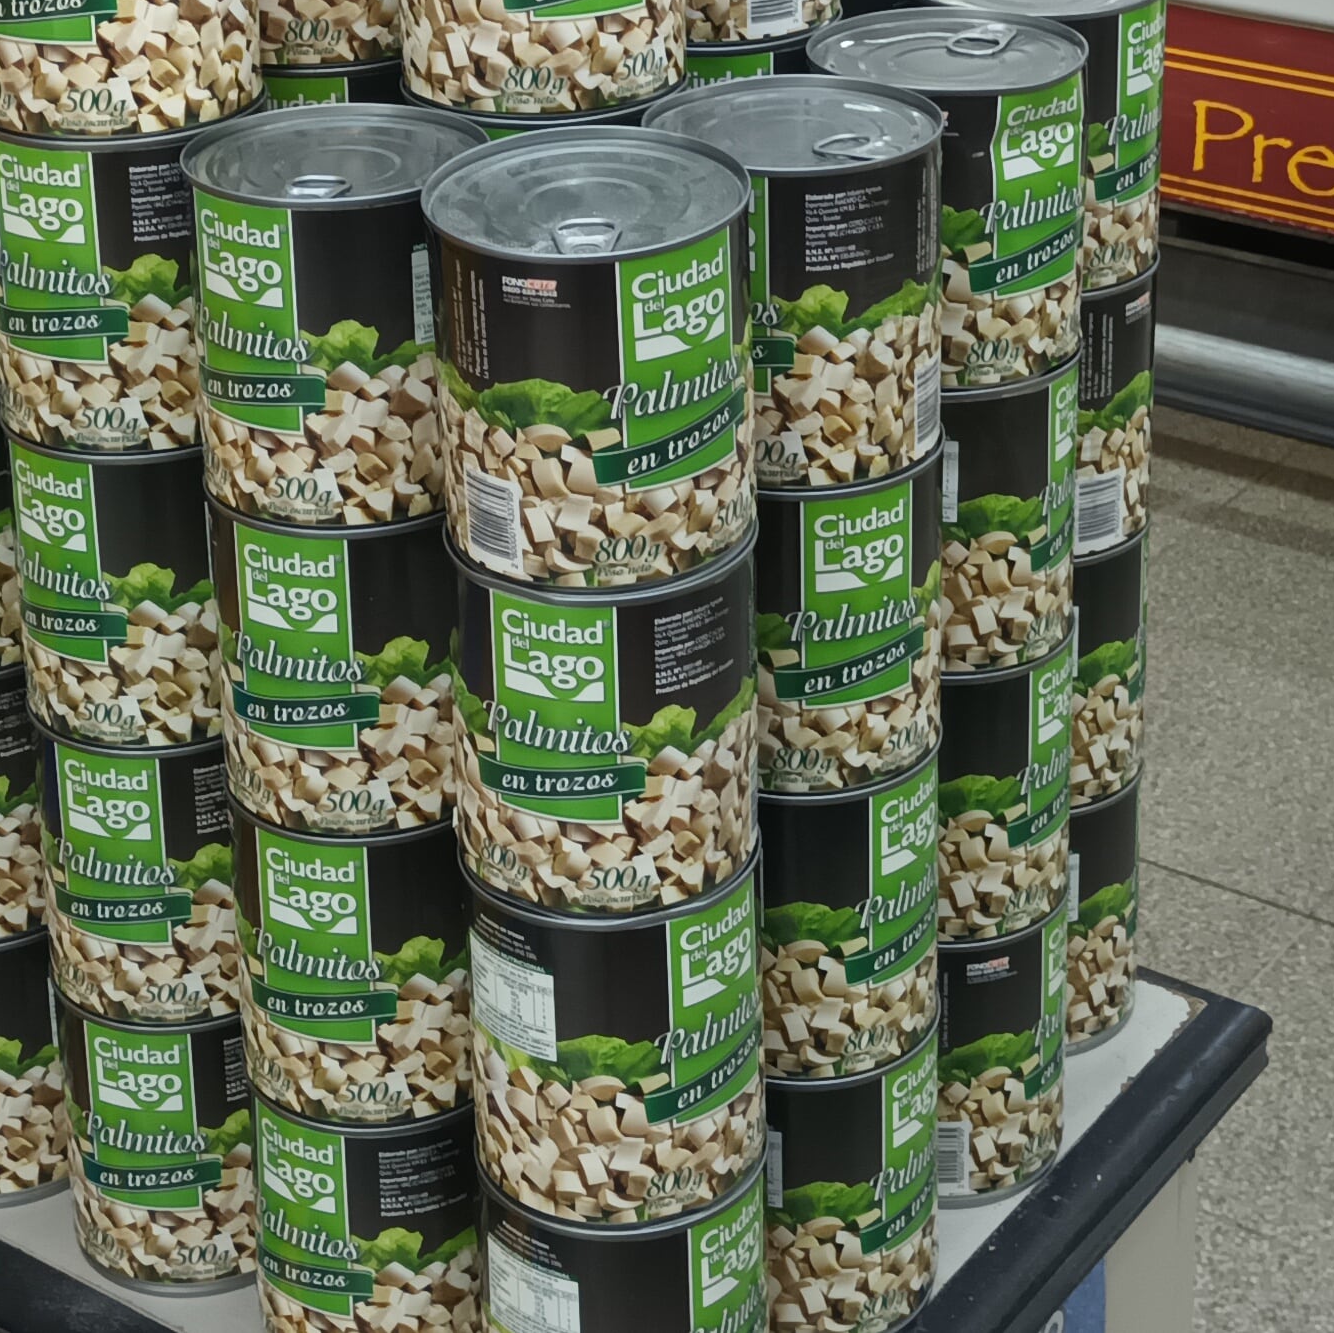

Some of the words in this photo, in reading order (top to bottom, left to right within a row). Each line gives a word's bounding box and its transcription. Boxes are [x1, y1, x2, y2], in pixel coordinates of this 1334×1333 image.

[1007, 90, 1078, 126] Ciudad
[1001, 121, 1074, 161] Lago
[2, 178, 84, 230] Lago
[6, 180, 20, 191] del
[981, 181, 1082, 233] Palmitos
[200, 209, 281, 249] Ciudad
[209, 237, 221, 250] del
[203, 234, 283, 294] Lago
[995, 262, 1021, 283] en
[1026, 229, 1076, 271] trozos
[632, 256, 725, 299] Ciudad
[9, 314, 27, 330] en
[32, 310, 100, 331] trozos
[634, 287, 725, 335] Lago
[645, 300, 664, 314] del
[198, 309, 310, 362] Palmitos
[207, 379, 223, 396] en
[227, 382, 295, 400] trozos
[604, 354, 740, 419] Palmitos
[627, 452, 661, 474] en
[667, 407, 732, 460] trozos
[813, 499, 905, 536] Ciudad
[243, 544, 337, 579] Ciudad
[815, 534, 904, 576] Lago
[825, 539, 844, 551] del
[248, 567, 338, 621] Lago
[252, 569, 267, 582] del
[501, 609, 603, 645] Ciudad
[784, 594, 918, 641] Palmitos
[235, 631, 365, 684] Palmitos
[505, 633, 605, 688] Lago
[511, 637, 530, 650] del
[804, 673, 835, 694] en
[841, 640, 908, 685] trozos
[247, 702, 268, 719] en
[272, 702, 350, 722] trozos
[484, 700, 633, 755] Palmitos
[64, 759, 149, 791] Ciudad
[73, 782, 86, 794] del
[502, 771, 528, 789] en
[533, 772, 617, 792] trozos
[67, 779, 150, 829] Lago
[57, 837, 176, 885] Palmitos
[265, 847, 356, 882] Ciudad
[274, 872, 290, 885] del
[71, 900, 93, 917] en
[96, 899, 165, 918] trozos
[269, 870, 357, 922] Lago
[253, 928, 382, 980] Palmitos
[267, 996, 288, 1013] en
[292, 996, 367, 1015] trozos
[94, 1036, 180, 1064] Ciudad
[96, 1057, 182, 1100] Lago
[85, 1109, 205, 1154] Palmitos
[100, 1169, 121, 1185] en
[125, 1166, 196, 1186] trozos
